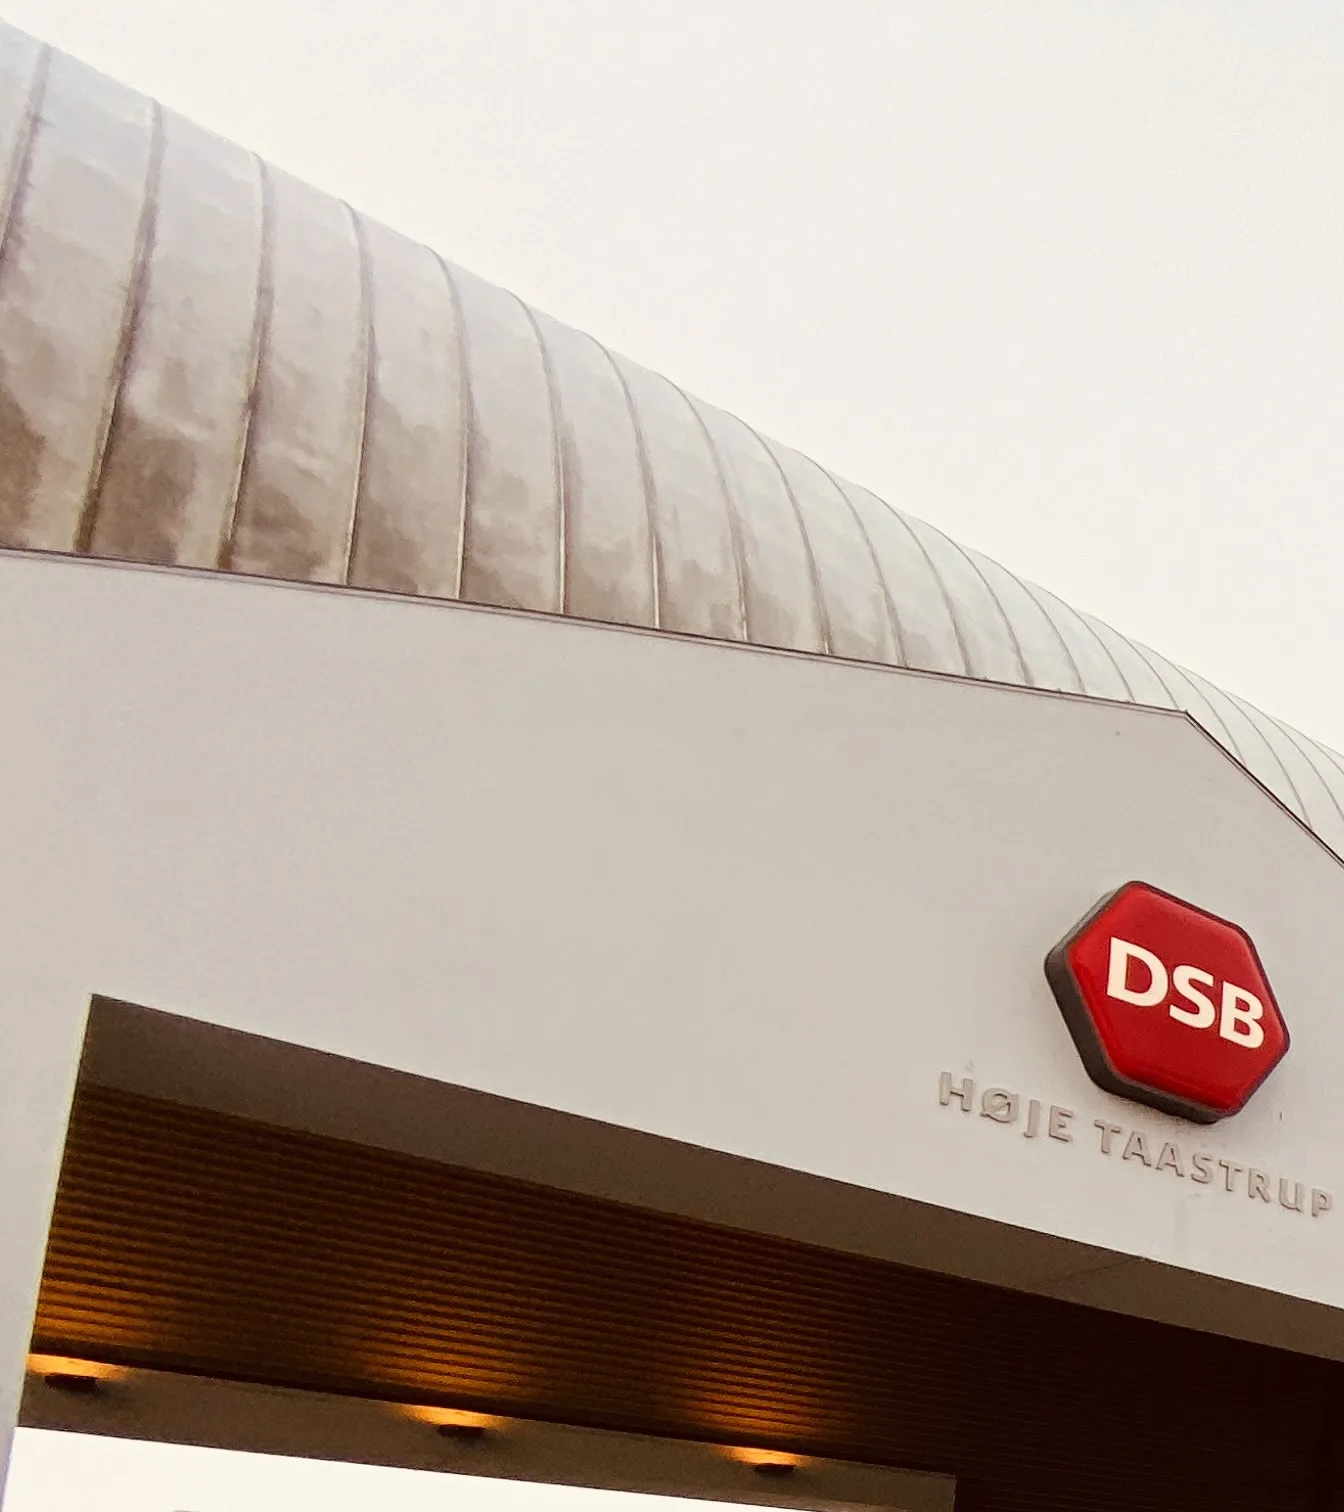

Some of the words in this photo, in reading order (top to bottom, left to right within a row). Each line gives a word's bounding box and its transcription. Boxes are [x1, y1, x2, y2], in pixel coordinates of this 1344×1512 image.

[1106, 936, 1265, 1049] DSB
[938, 1071, 1074, 1142] HØJE
[1094, 1118, 1334, 1217] TAASTRUP
